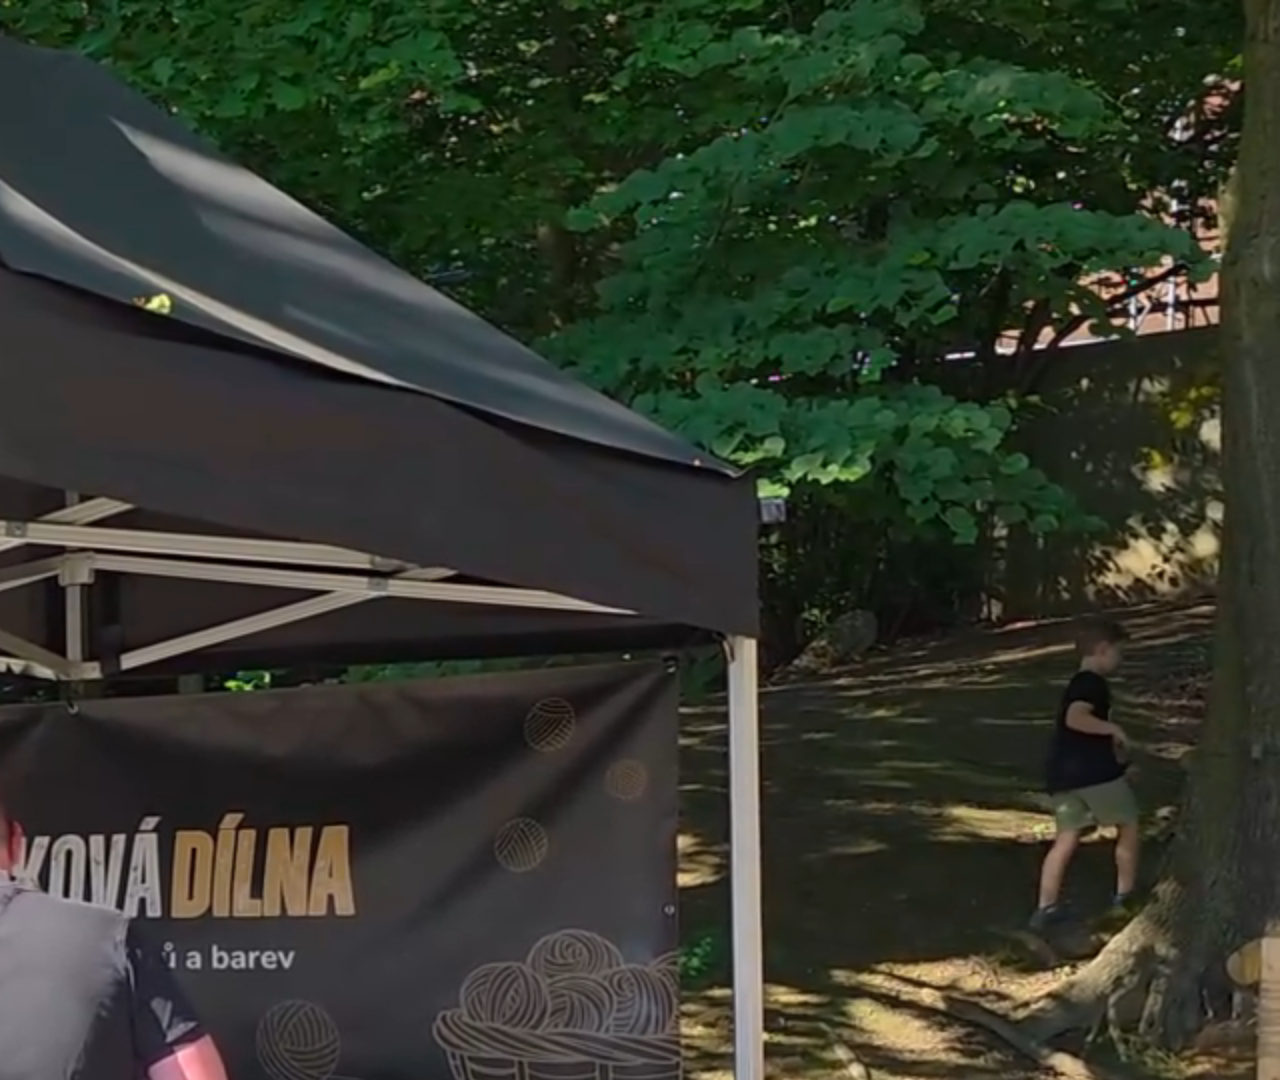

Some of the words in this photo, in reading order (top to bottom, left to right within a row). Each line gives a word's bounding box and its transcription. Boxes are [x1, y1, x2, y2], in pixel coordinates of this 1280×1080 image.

[169, 813, 357, 919] DÍLNA
[185, 950, 203, 970] a
[211, 944, 296, 970] barev
